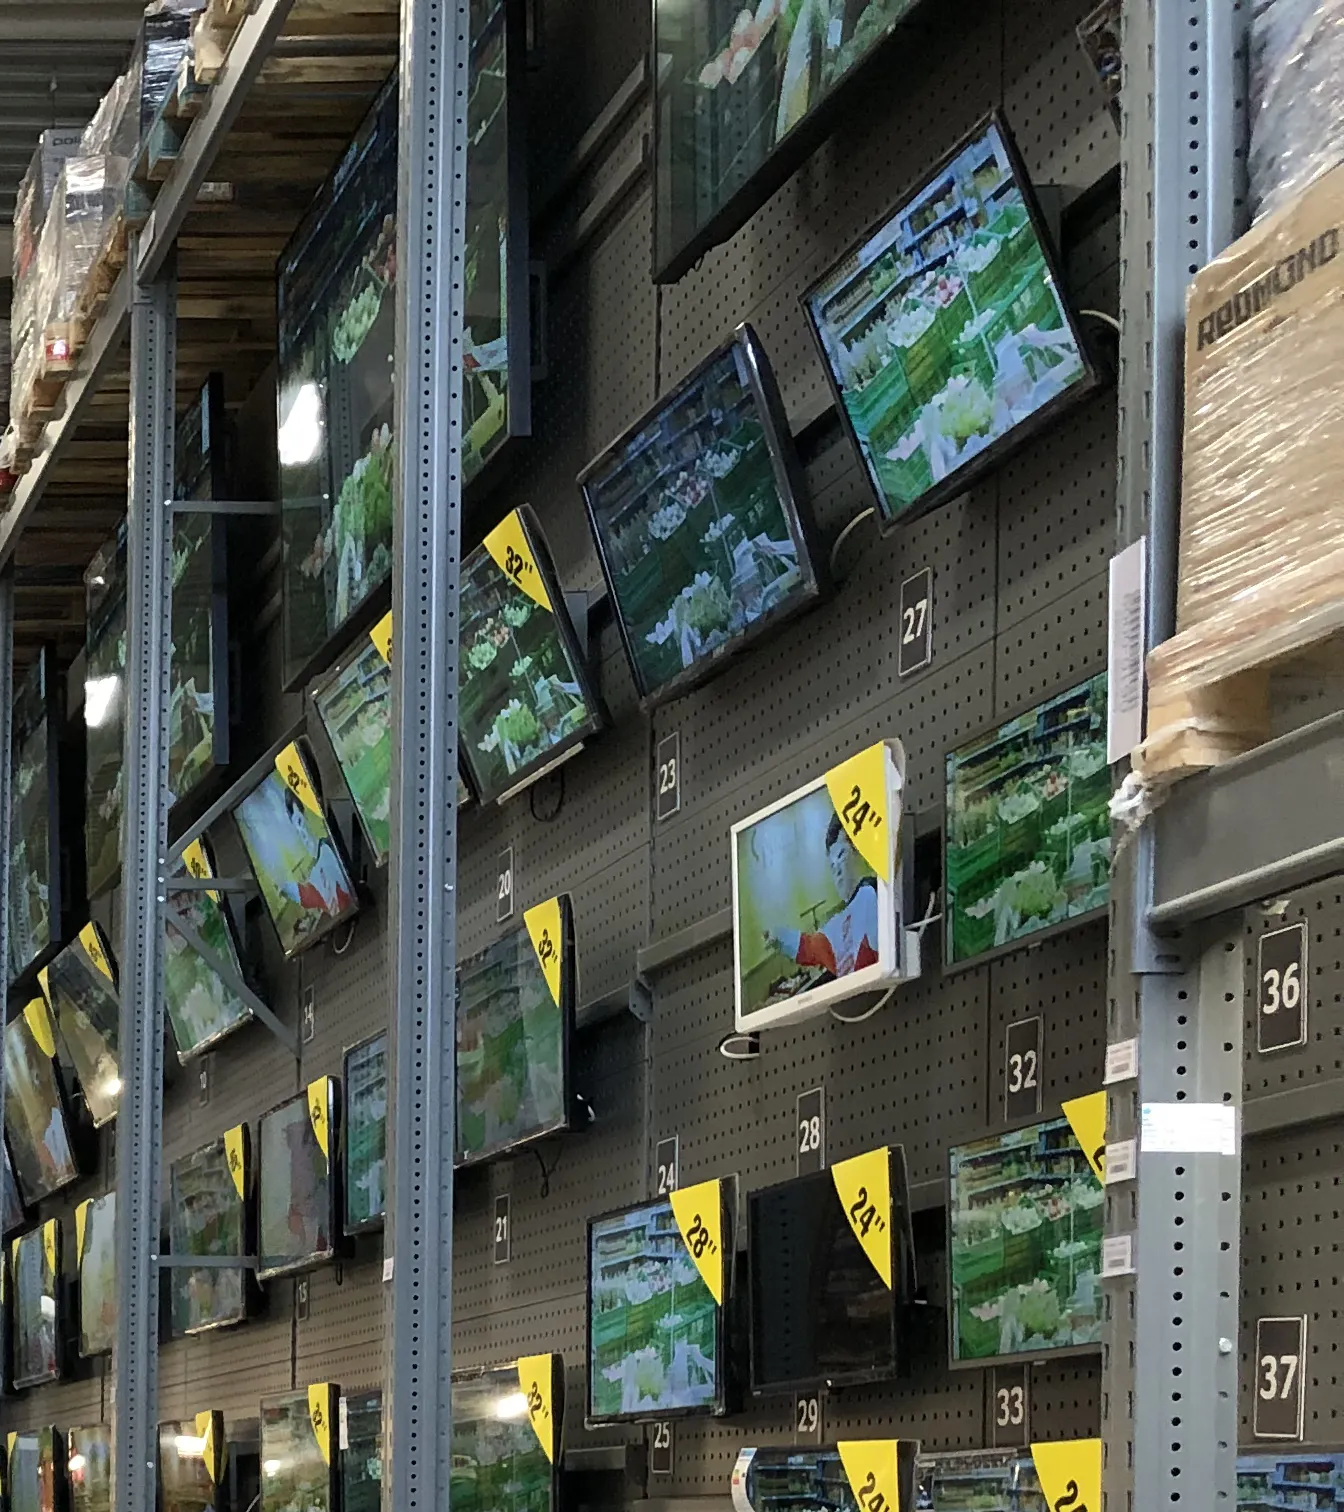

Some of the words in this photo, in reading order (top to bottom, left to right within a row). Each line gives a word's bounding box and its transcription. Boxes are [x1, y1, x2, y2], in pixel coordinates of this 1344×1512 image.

[505, 545, 533, 584] 32"
[903, 599, 927, 645] 27
[660, 758, 676, 794] 23
[842, 784, 883, 836] 24"
[498, 869, 511, 900] 20
[1262, 961, 1300, 1015] 36
[1008, 1049, 1037, 1093] 32
[799, 1115, 820, 1153] 28
[658, 1162, 675, 1195] 24
[495, 1215, 508, 1243] 21
[850, 1186, 886, 1238] 24"
[686, 1213, 718, 1258] 28"
[1259, 1354, 1298, 1400] 37
[797, 1398, 818, 1432] 29
[997, 1386, 1024, 1427] 33
[654, 1421, 670, 1449] 25
